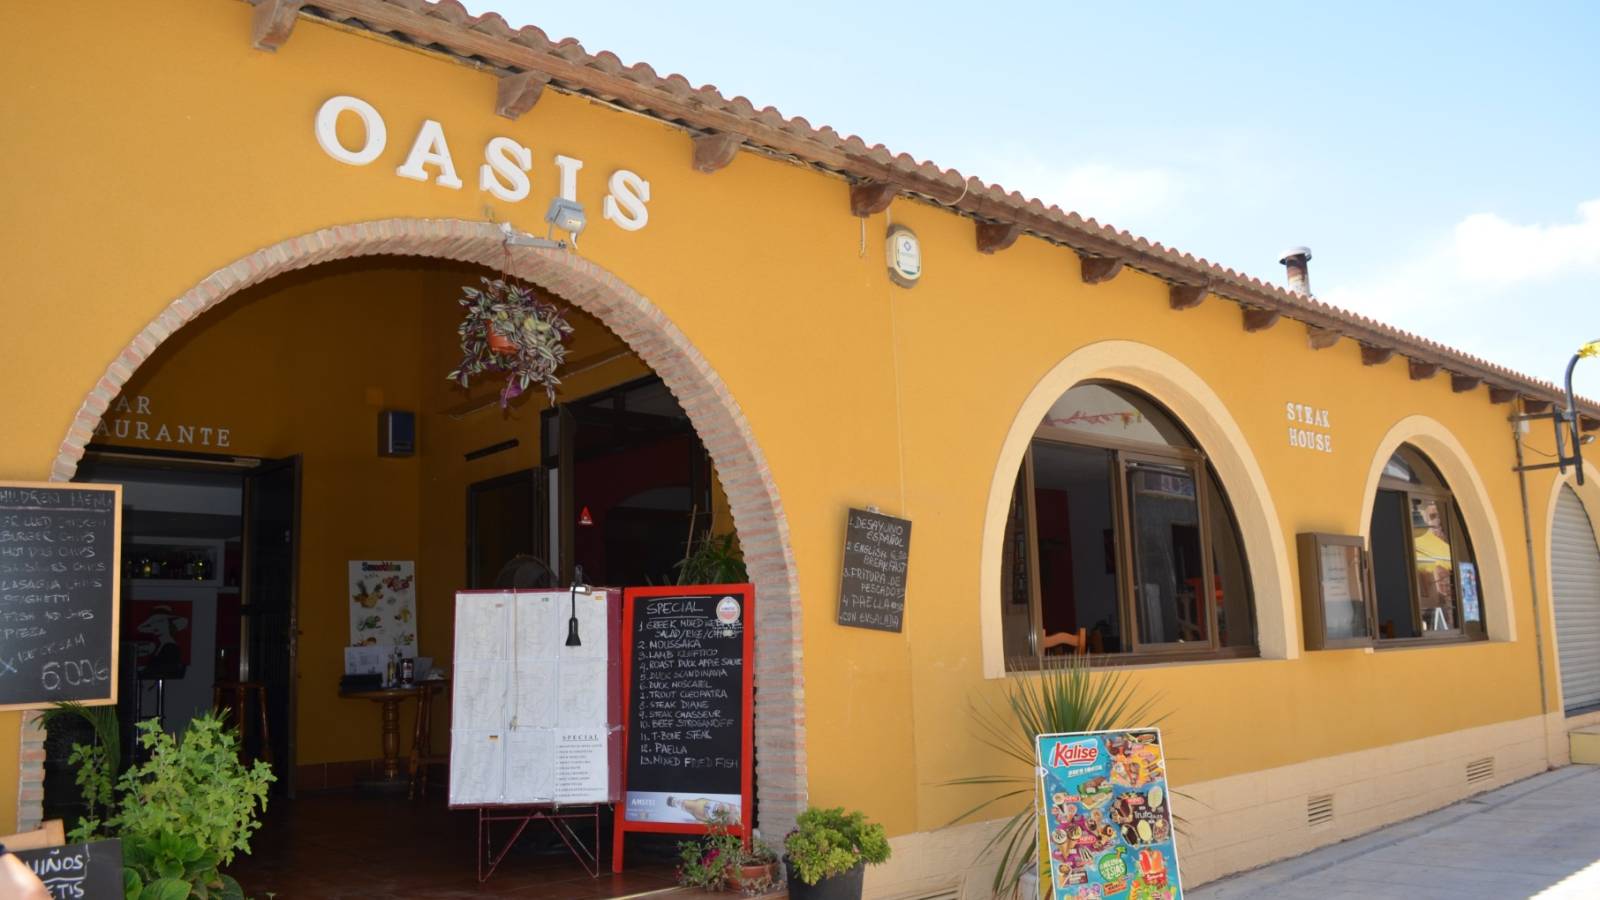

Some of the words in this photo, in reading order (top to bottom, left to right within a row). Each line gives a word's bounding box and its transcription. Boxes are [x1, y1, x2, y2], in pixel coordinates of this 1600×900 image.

[314, 95, 650, 232] OASIS
[1287, 402, 1330, 428] STEAK
[1288, 427, 1332, 453] HOUSE
[855, 517, 904, 536] DESAYUNO
[866, 531, 905, 548] ESPAÑOL
[854, 542, 887, 559] ENGLISH
[851, 567, 886, 583] FRITURA
[646, 601, 704, 615] SPECIAL
[852, 595, 890, 609] PAELLA
[649, 639, 702, 650] MOUSSAKA
[649, 650, 674, 659] LAMB
[650, 659, 675, 670] ROAST
[678, 658, 697, 668] DUCK
[698, 658, 720, 667] APPLE
[649, 681, 669, 690] DUCK
[650, 690, 676, 699] TROUT
[680, 688, 729, 699] CLEOPATRA
[650, 700, 676, 710] STEAK
[681, 699, 710, 710] DIANE
[650, 709, 673, 719] STEAK
[652, 719, 674, 729] BEEF
[652, 730, 681, 741] T-BONE
[686, 728, 713, 741] STEAK
[655, 742, 687, 755] PAELLA
[1053, 742, 1098, 768] Kalise
[653, 755, 681, 767] MIXED
[715, 757, 739, 769] FISH
